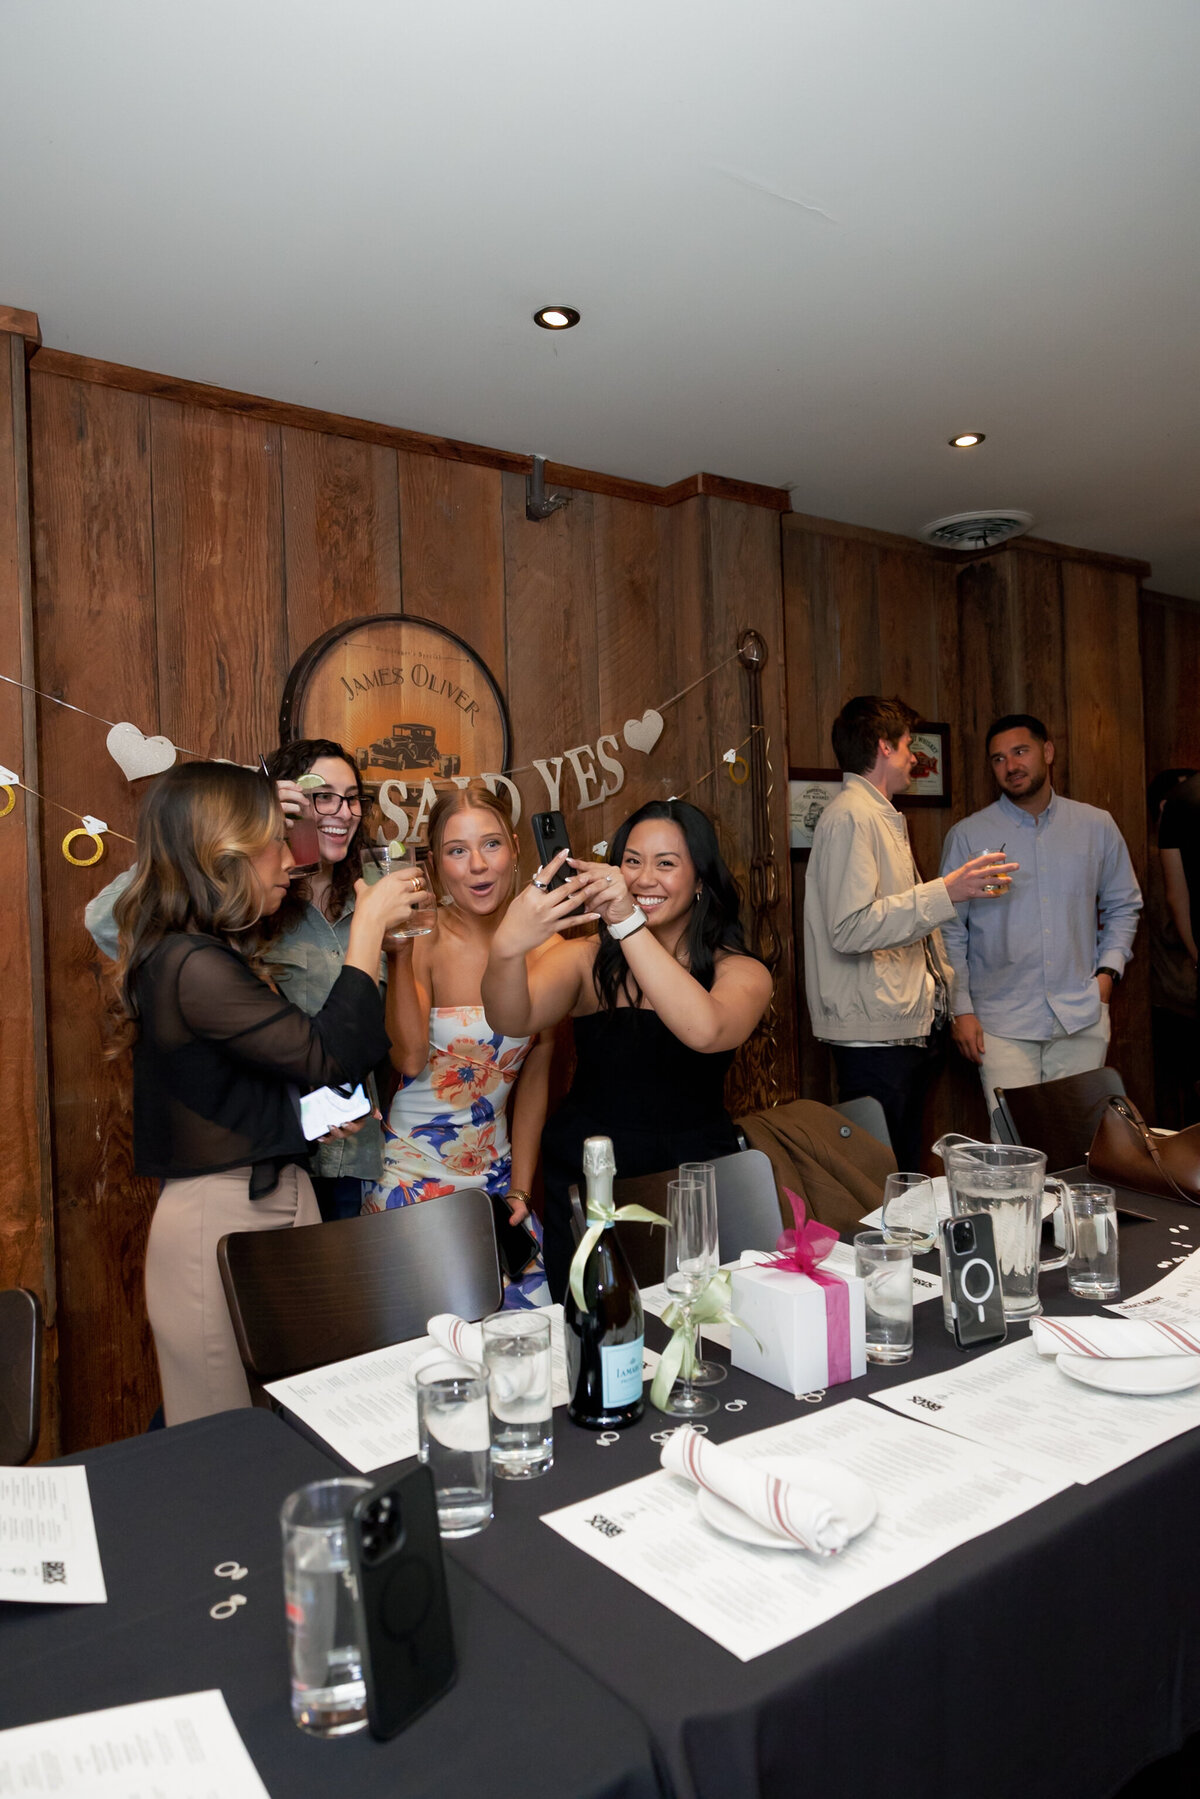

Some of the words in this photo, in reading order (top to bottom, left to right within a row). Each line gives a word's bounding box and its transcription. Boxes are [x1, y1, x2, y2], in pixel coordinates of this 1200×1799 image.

[340, 667, 405, 701] JAMES
[411, 663, 480, 728] OLIVER
[376, 773, 521, 845] SAD
[532, 735, 625, 812] YES
